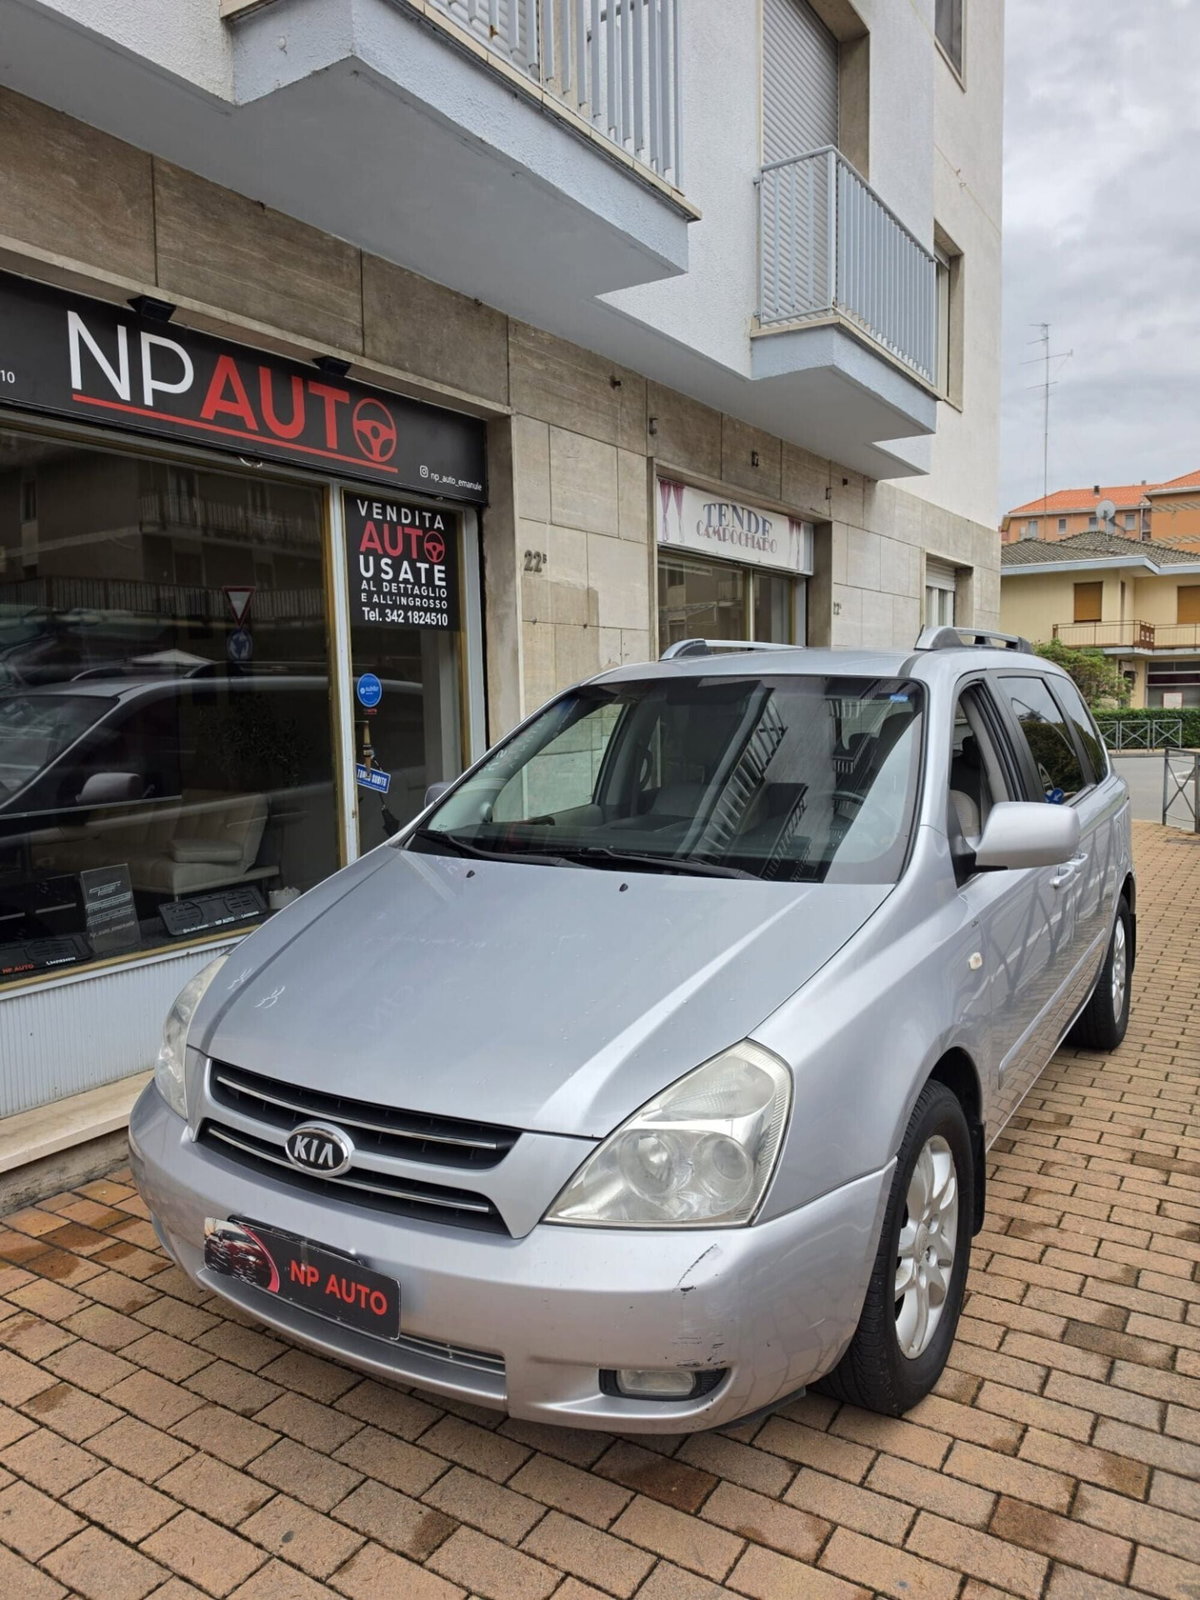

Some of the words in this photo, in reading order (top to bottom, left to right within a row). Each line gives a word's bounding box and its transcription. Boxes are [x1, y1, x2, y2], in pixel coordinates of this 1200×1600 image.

[357, 499, 445, 530] VENDITA
[703, 503, 773, 536] TENDE
[359, 554, 447, 587] USATE
[361, 580, 377, 591] AL
[382, 582, 448, 598] DETTAGLIO
[361, 593, 368, 602] E
[372, 594, 448, 609] ALL'INGROSSO
[362, 607, 383, 622] Tel.
[385, 609, 405, 623] 342
[408, 611, 448, 627] 1824510
[293, 1134, 336, 1168] KIA
[290, 1260, 320, 1287] NP
[325, 1274, 389, 1315] AUTO
